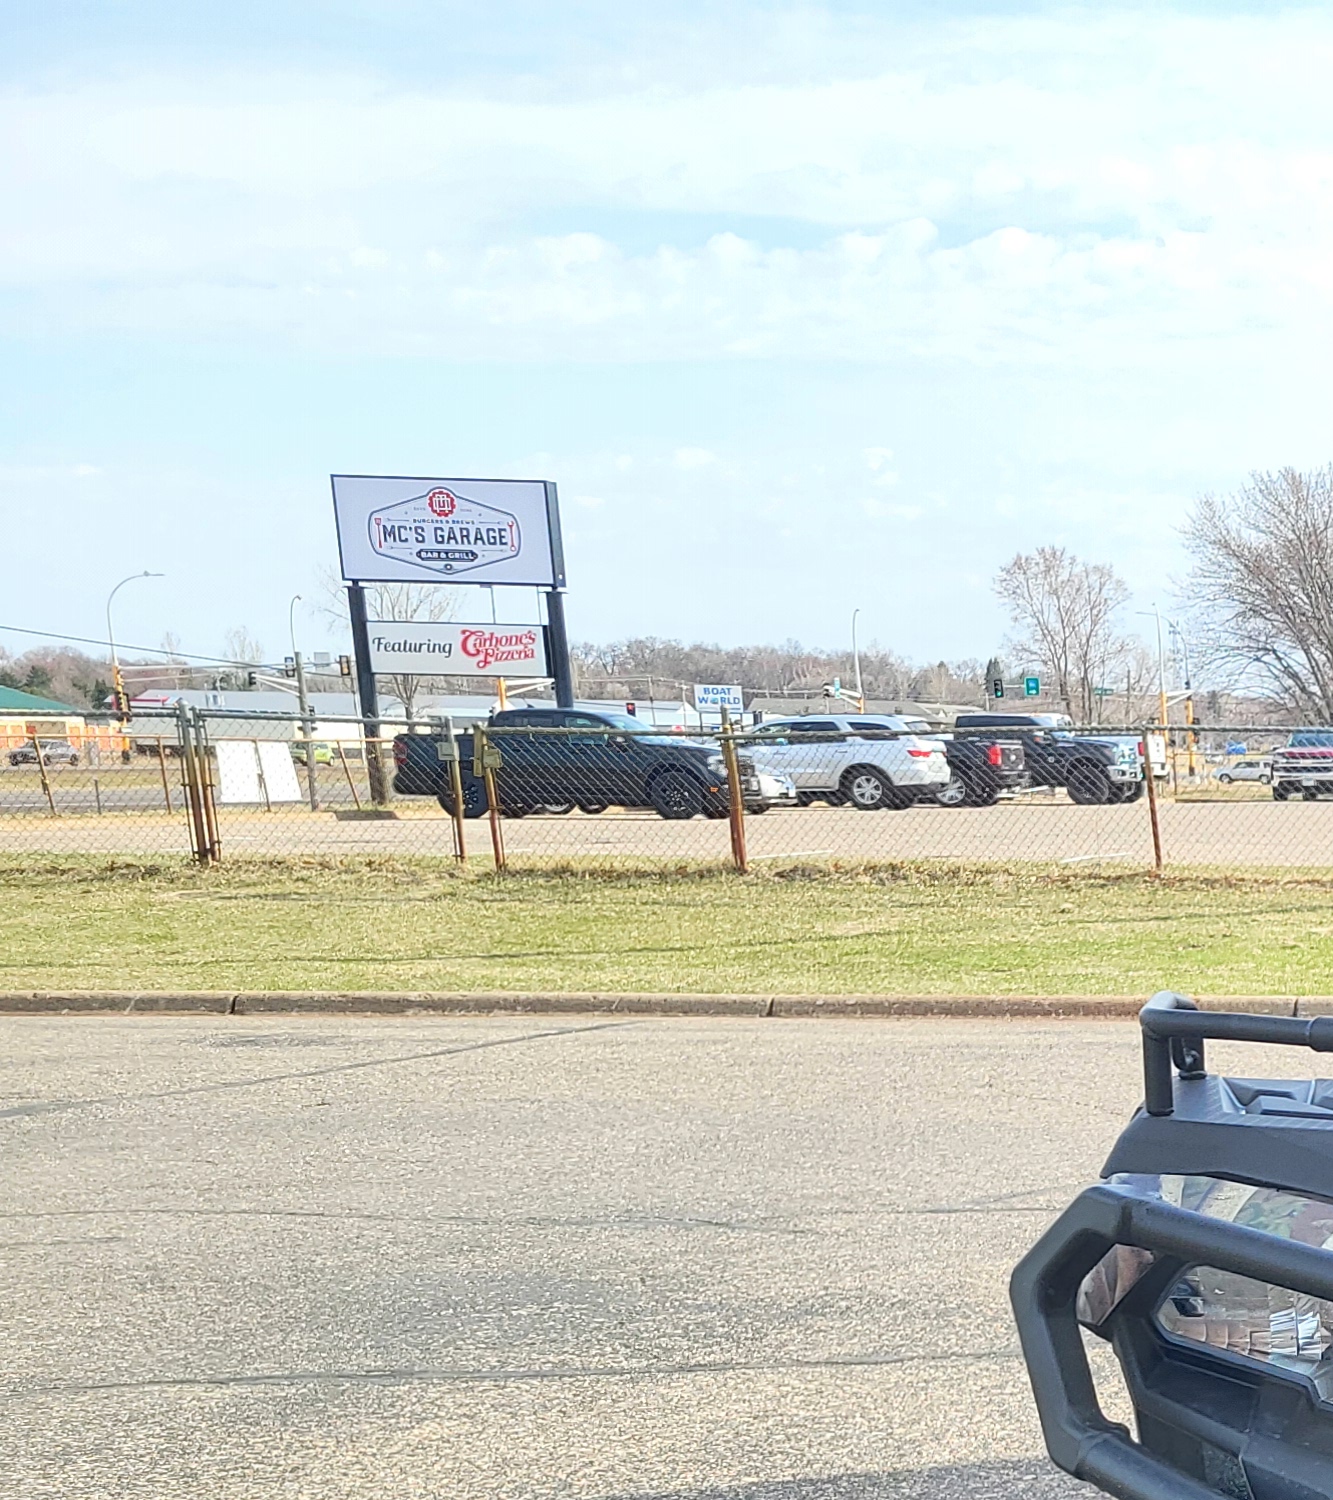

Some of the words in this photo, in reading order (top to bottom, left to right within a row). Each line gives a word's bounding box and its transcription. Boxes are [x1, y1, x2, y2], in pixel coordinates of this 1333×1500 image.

[382, 524, 426, 544] MC'S
[434, 526, 508, 546] GARAGE
[447, 552, 474, 560] GRILL
[372, 636, 453, 658] Featuring
[460, 629, 537, 657] Carbone's
[476, 647, 536, 669] Pizzeria
[697, 696, 740, 705] WORLD
[703, 687, 733, 695] BOAT
